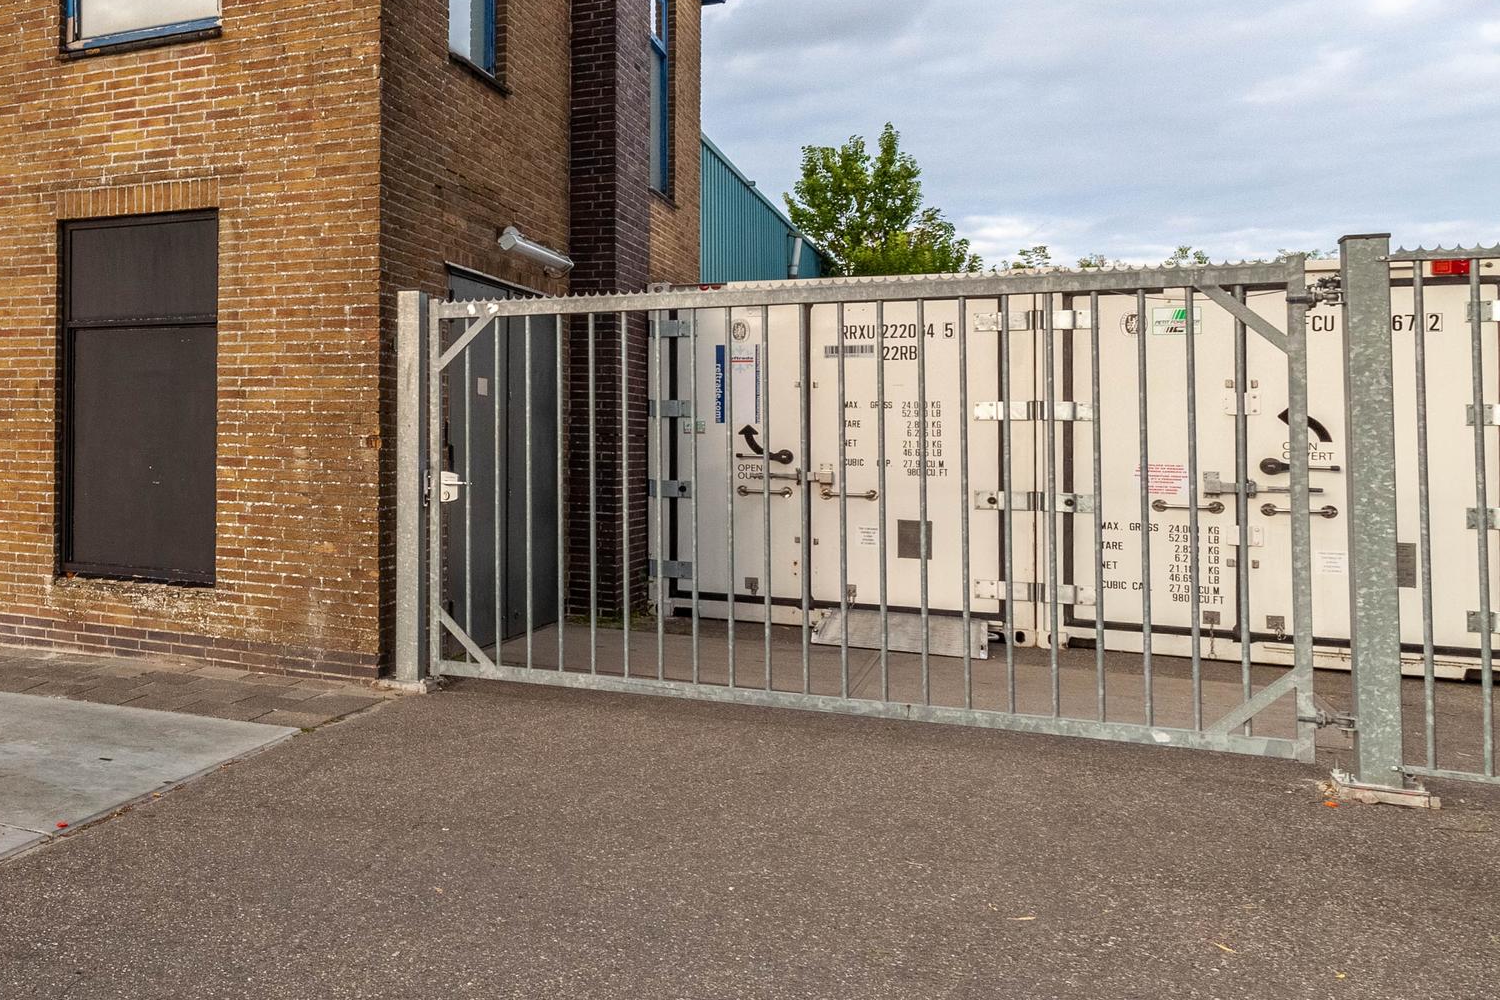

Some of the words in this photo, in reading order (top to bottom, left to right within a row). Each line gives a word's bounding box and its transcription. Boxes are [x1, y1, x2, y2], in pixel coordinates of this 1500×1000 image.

[1428, 314, 1440, 331] 2
[882, 323, 935, 338] 22204
[943, 322, 954, 338] 5
[882, 345, 917, 360] 22RB
[870, 401, 893, 409] GRSS
[902, 401, 928, 409] 24.00
[931, 401, 941, 409] KG
[931, 410, 941, 418] LB
[931, 421, 941, 429] KG
[932, 430, 942, 438] LB
[1282, 441, 1317, 451] ON
[932, 449, 942, 457] LB
[1282, 451, 1335, 461] OERT
[738, 464, 763, 472] OPEN
[1129, 523, 1159, 532] GRSS
[1208, 526, 1220, 535] KG
[1208, 536, 1220, 544] LB
[1208, 546, 1220, 555] KG
[1208, 556, 1220, 564] LB
[1208, 566, 1220, 575] KG
[1208, 576, 1220, 584] LB
[1102, 580, 1127, 589] CUBIC
[1132, 581, 1152, 591] CA.
